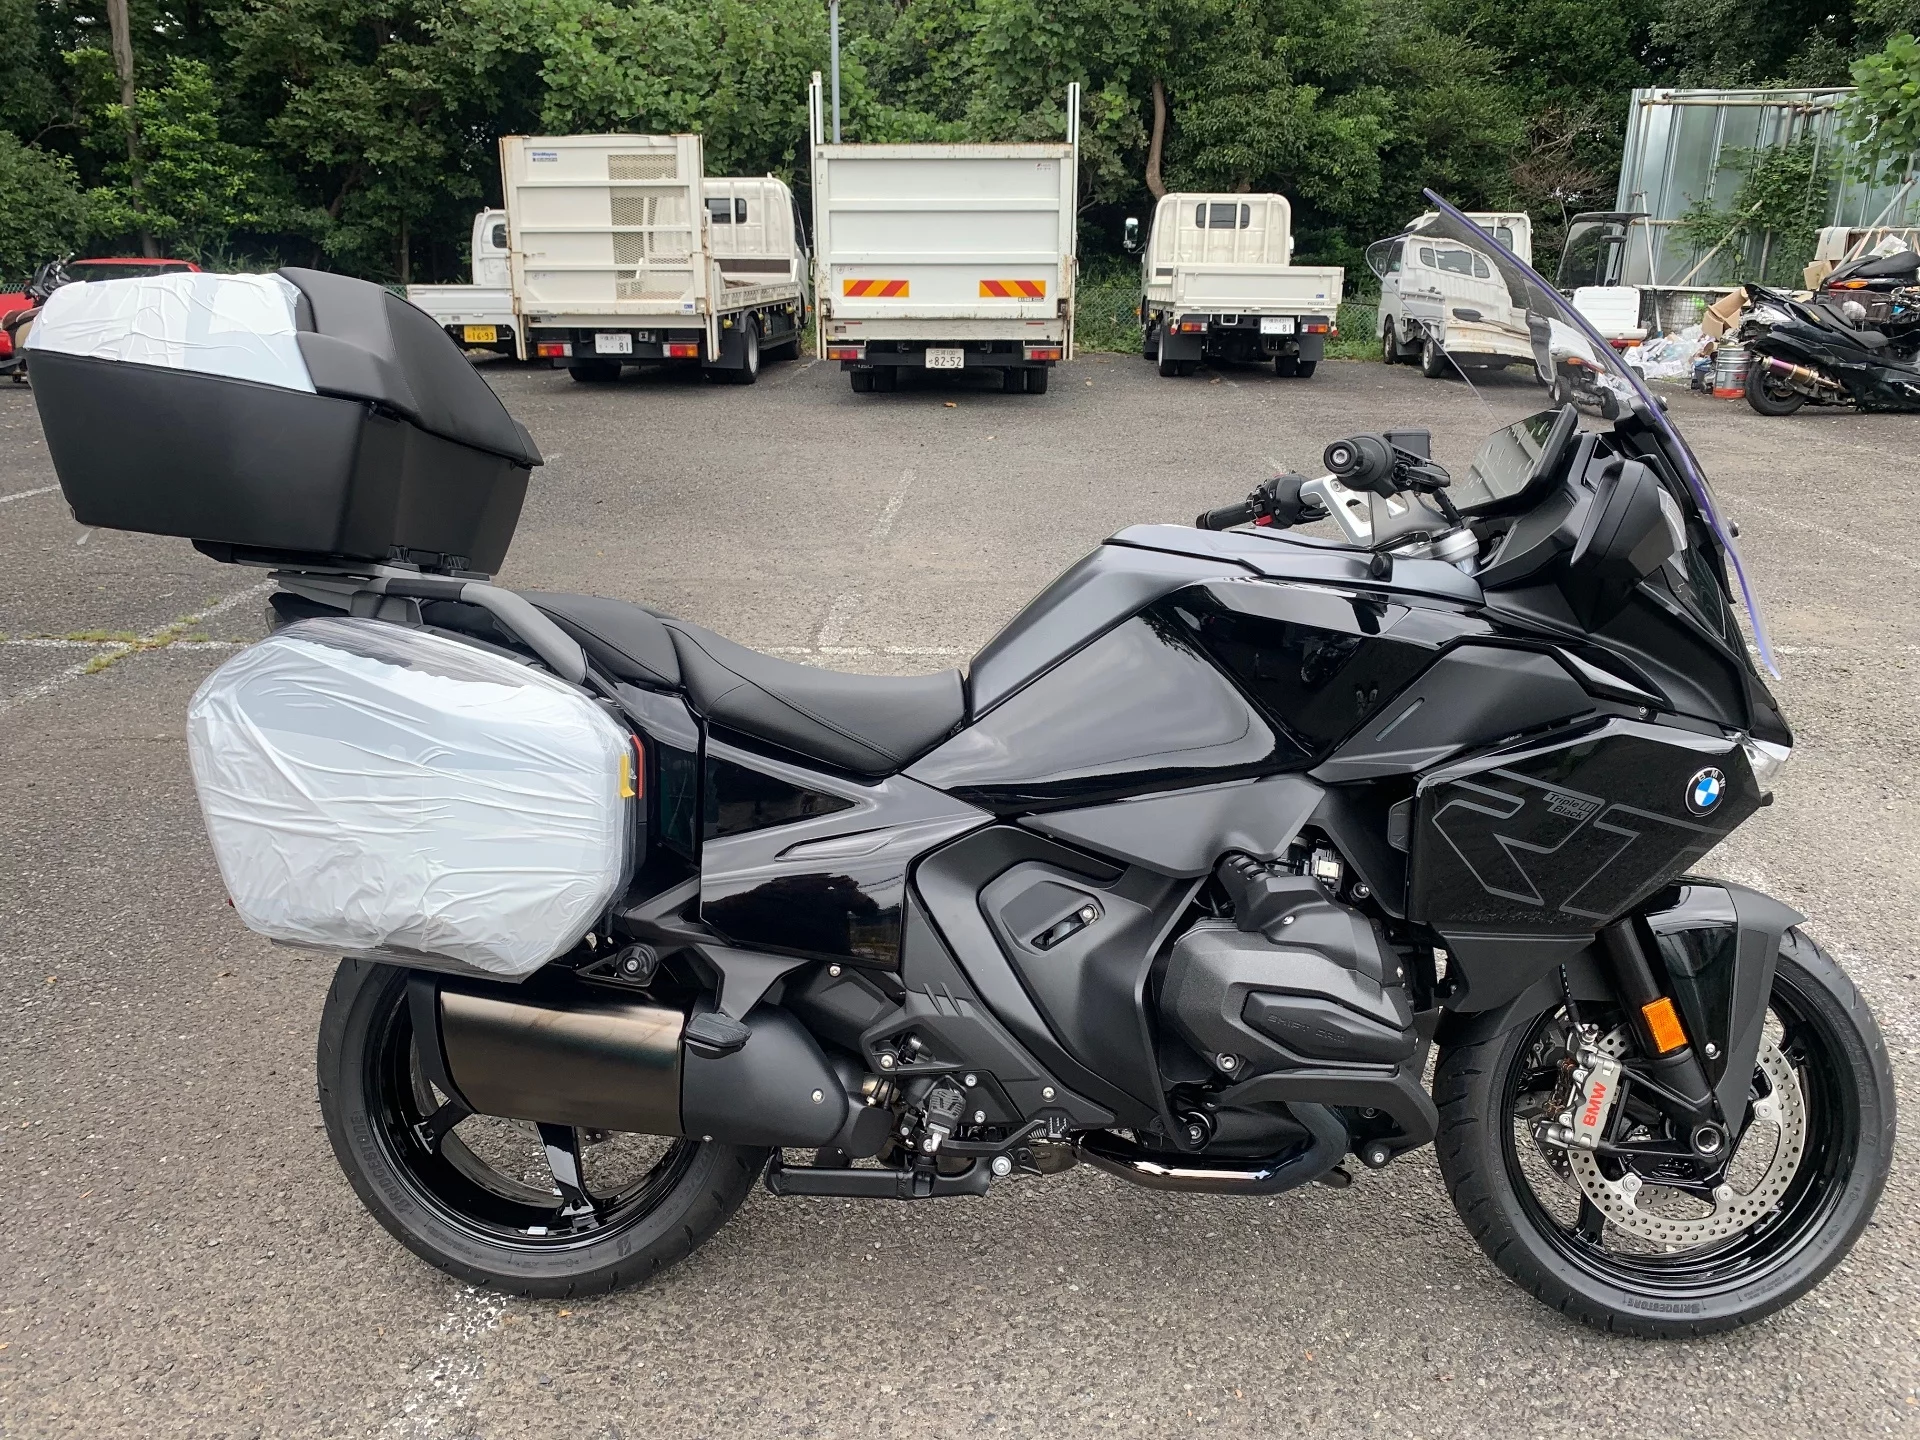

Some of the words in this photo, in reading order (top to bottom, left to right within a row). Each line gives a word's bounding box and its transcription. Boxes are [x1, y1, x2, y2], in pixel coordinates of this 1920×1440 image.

[934, 356, 962, 367] 82-52
[1697, 769, 1726, 788] BMW
[1549, 793, 1580, 808] Triple
[1552, 805, 1583, 819] Black
[1582, 1081, 1607, 1127] BMW
[350, 1110, 413, 1214] BRIDGESTONE
[1627, 1297, 1700, 1314] BRIDGESTONE
